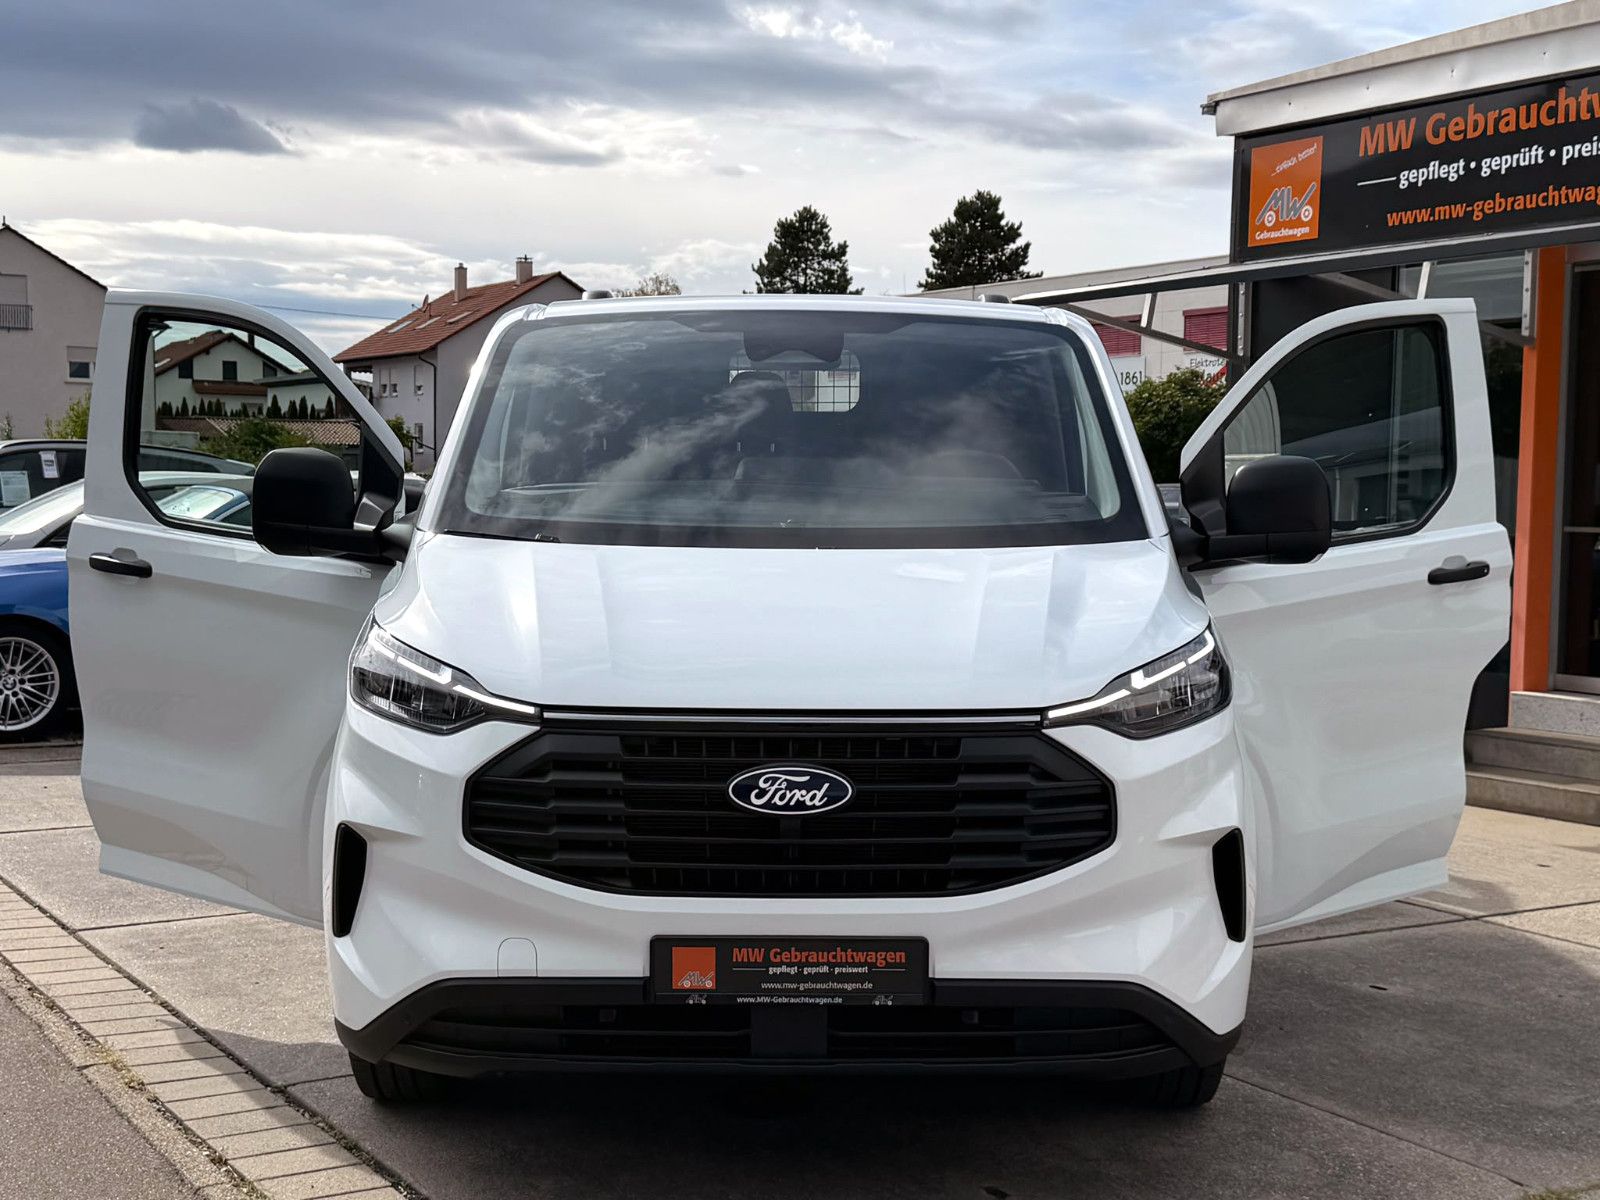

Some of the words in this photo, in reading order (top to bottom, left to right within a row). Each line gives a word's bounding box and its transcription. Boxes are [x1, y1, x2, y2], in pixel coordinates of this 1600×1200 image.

[1358, 116, 1417, 158] MW
[1399, 157, 1466, 189] gepflegt
[1480, 145, 1545, 177] geprüft
[1256, 181, 1317, 226] MW
[1255, 225, 1310, 240] Gebrauchtwagen
[1120, 370, 1143, 386] 1861
[750, 773, 830, 807] Ford
[732, 947, 765, 963] MW
[769, 947, 906, 967] Gebrauchtwagen
[768, 966, 798, 975] gepflegt
[803, 966, 829, 975] geprüft
[834, 966, 868, 975] preiswert
[761, 981, 873, 991] www.mw-gebrauchtwagen.de
[736, 996, 843, 1006] www.MW-Gebrauchtwagen.de
